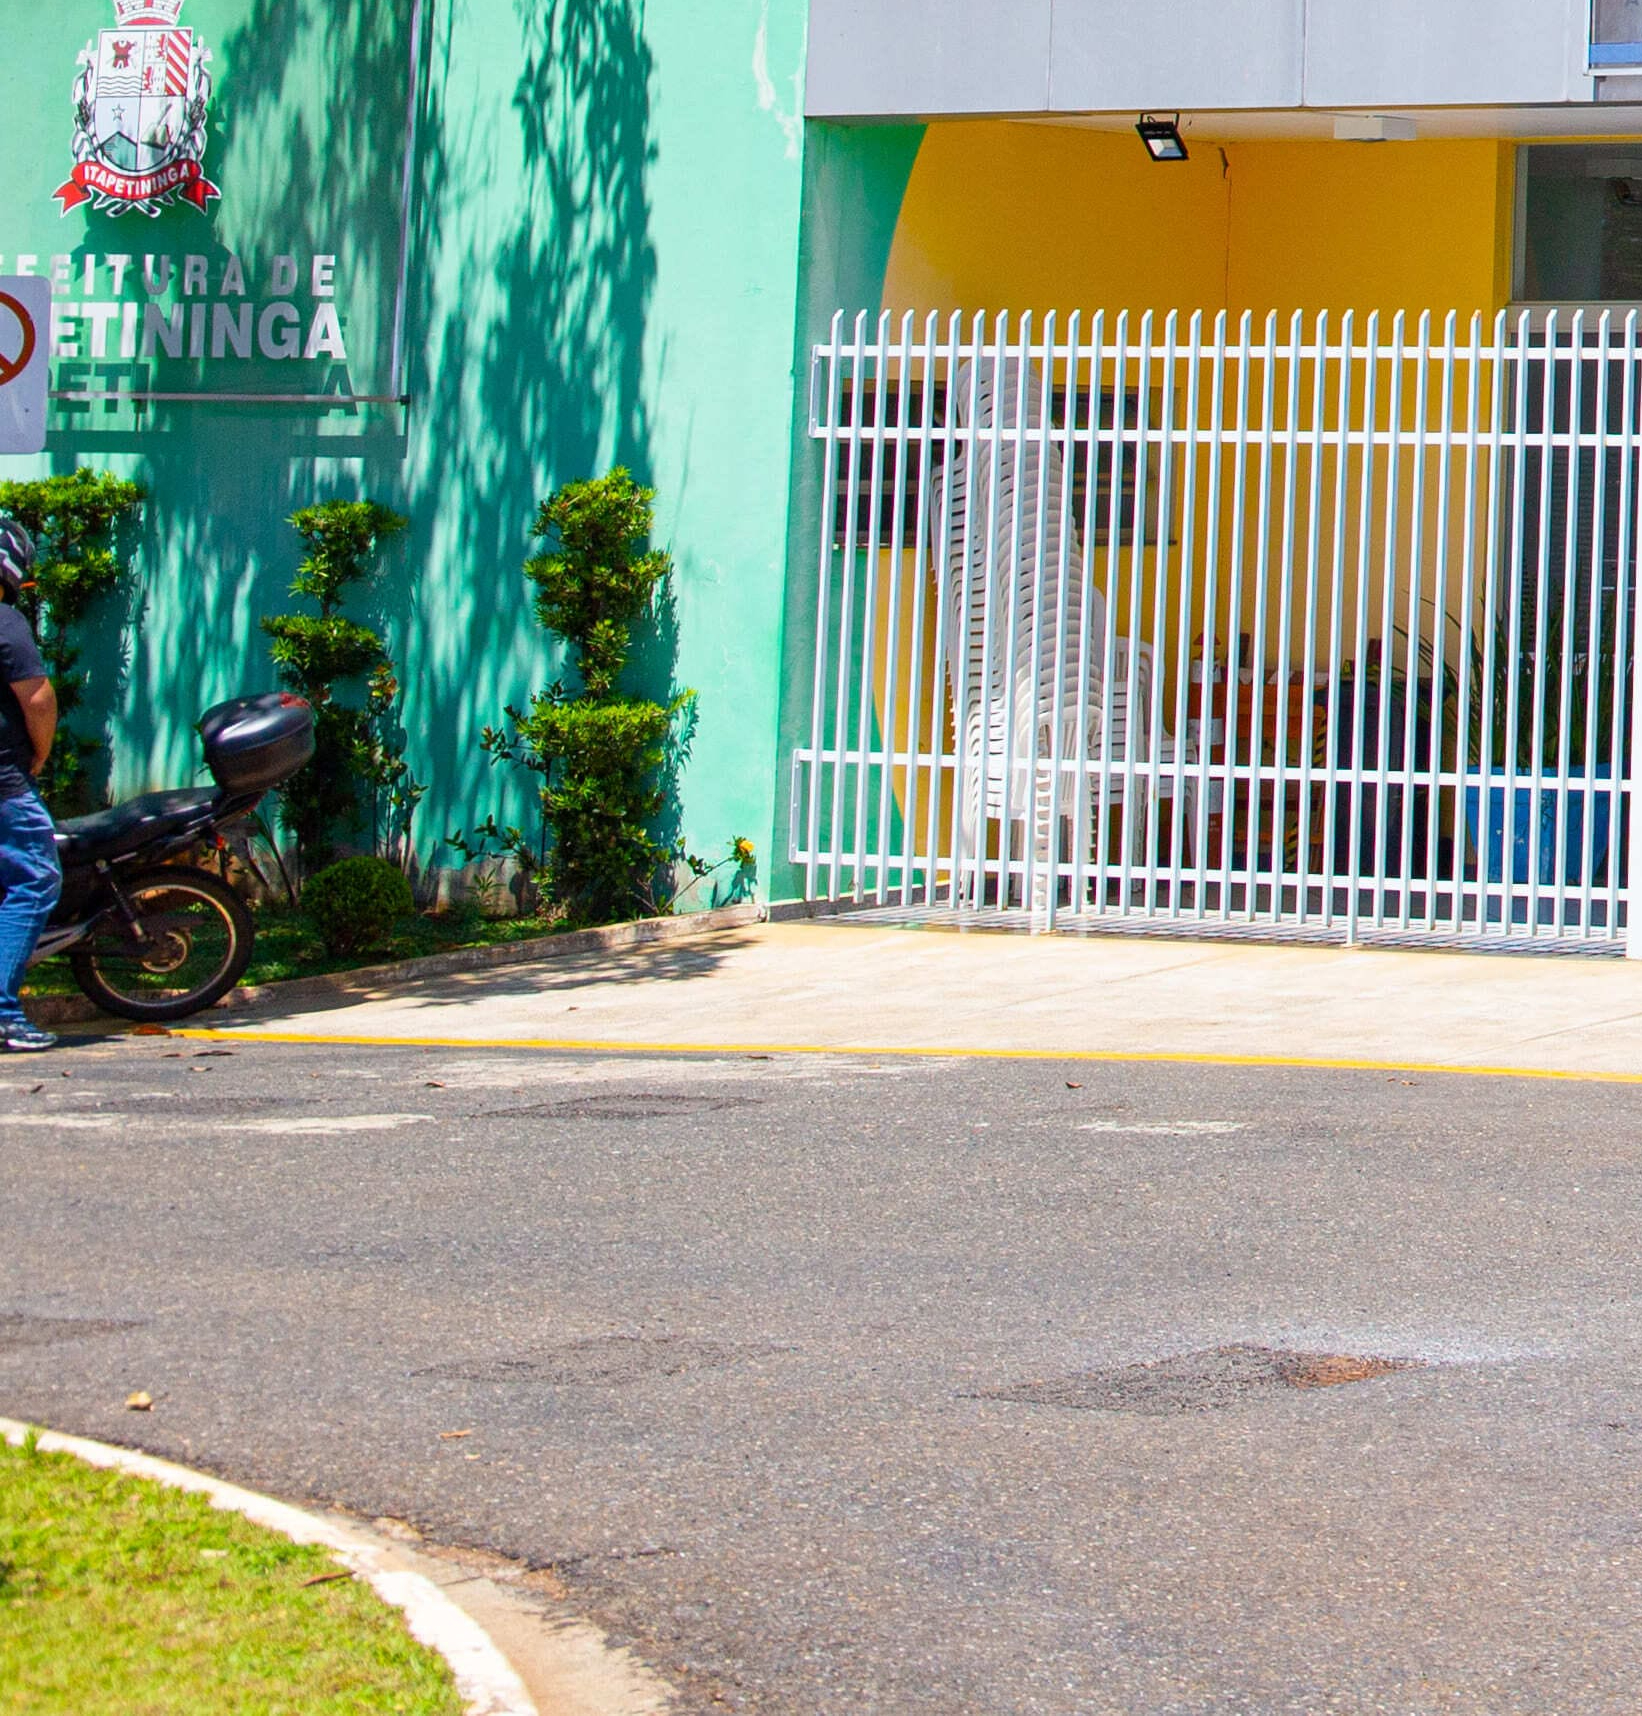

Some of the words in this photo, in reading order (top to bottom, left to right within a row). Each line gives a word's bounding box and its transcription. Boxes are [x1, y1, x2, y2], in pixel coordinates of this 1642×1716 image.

[84, 163, 189, 196] ITAPETININGA
[0, 254, 246, 296] FEITURA
[271, 254, 336, 297] DE
[51, 302, 347, 360] ETININGA
